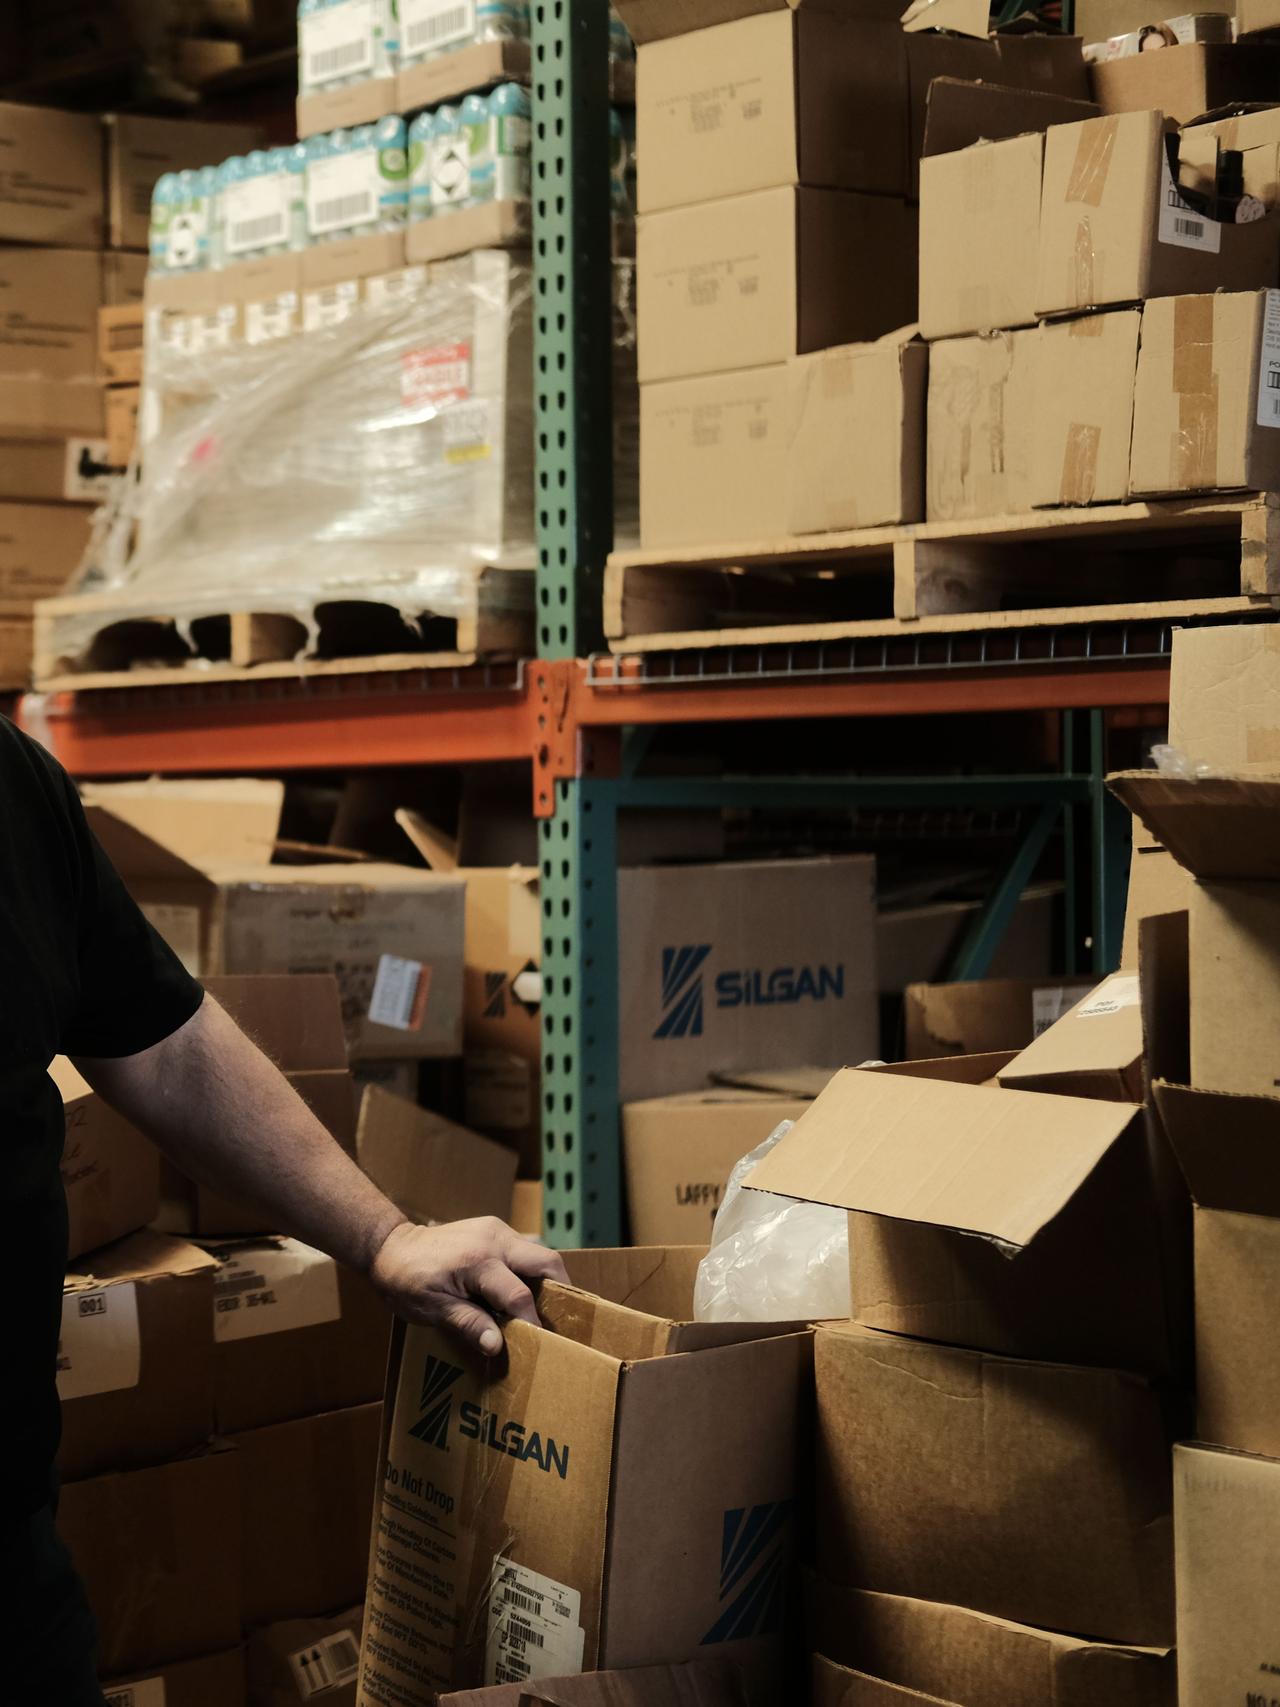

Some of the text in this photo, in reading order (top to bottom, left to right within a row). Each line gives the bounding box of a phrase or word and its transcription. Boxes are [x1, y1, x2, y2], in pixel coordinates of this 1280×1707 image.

[80, 1298, 104, 1314] 001
[402, 1469, 423, 1497] Not
[425, 1482, 454, 1516] Drop
